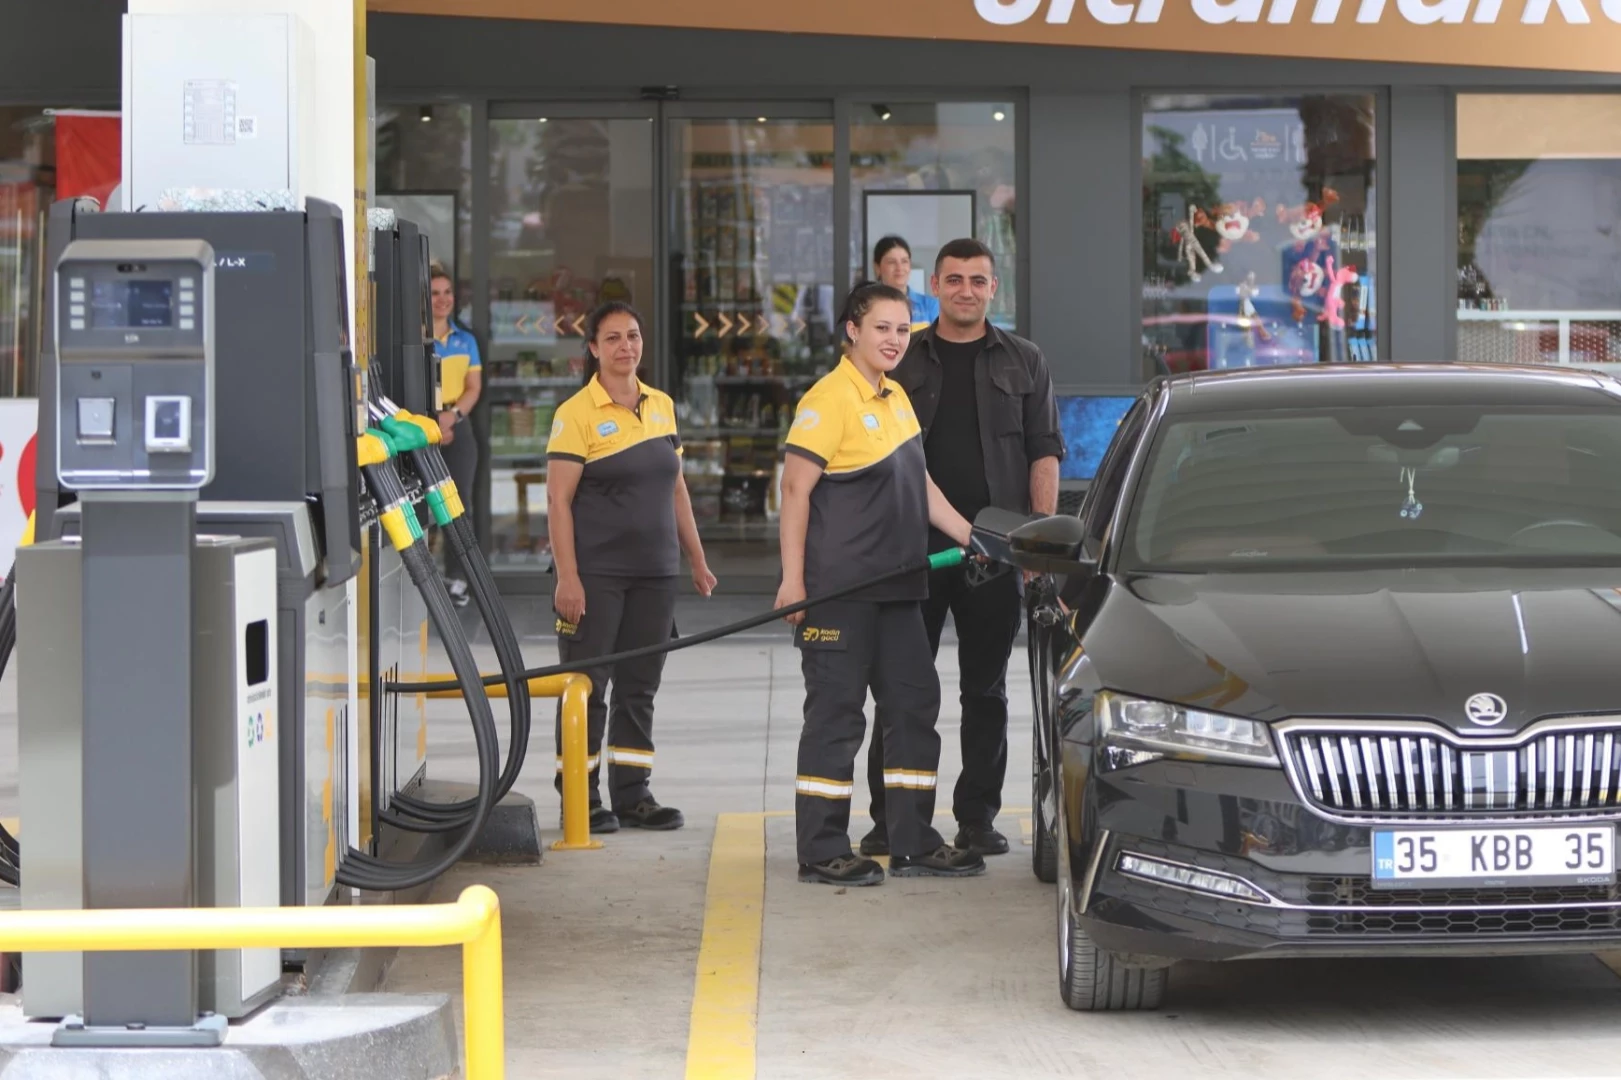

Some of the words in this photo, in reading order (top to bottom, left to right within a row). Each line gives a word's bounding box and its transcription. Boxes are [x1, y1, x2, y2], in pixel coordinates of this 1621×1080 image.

[1378, 859, 1393, 870] TR
[1397, 836, 1437, 872] 35
[1471, 835, 1533, 871] KBB
[1564, 833, 1604, 869] 35
